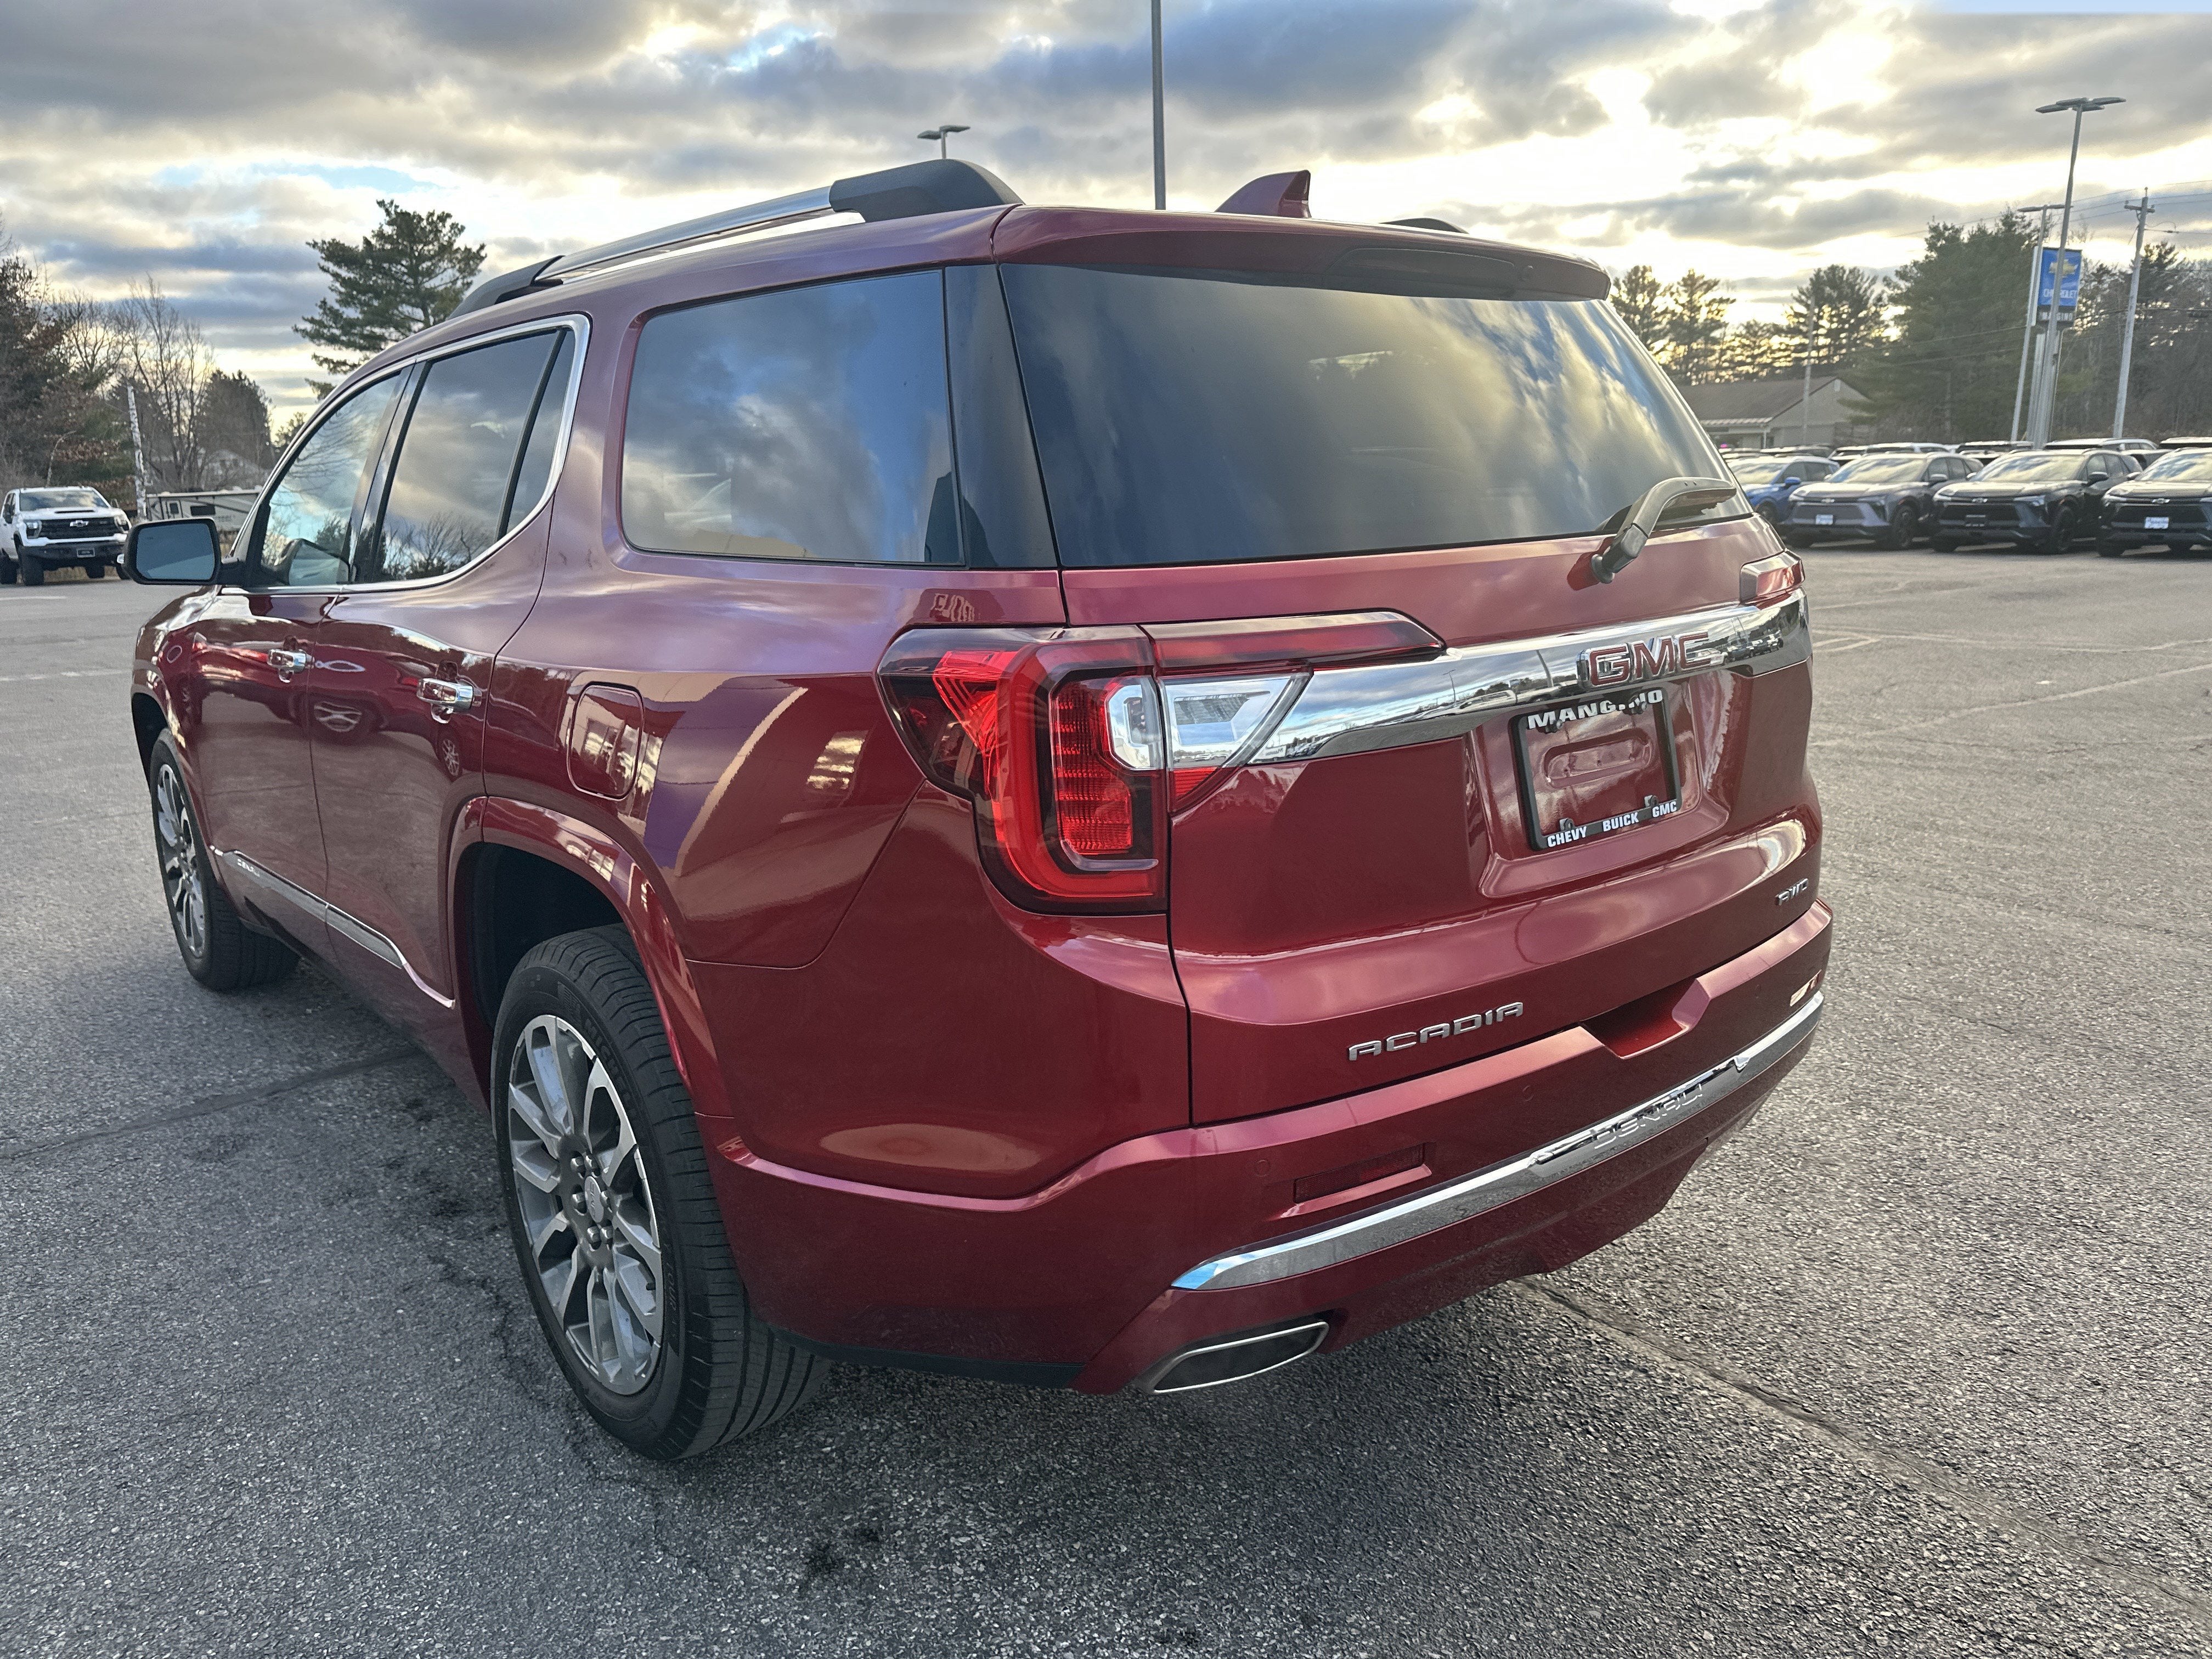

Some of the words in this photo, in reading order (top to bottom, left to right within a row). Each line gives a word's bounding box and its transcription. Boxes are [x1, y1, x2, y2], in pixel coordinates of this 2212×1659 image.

[1588, 629, 1712, 687] GMC
[1547, 826, 1587, 848] CHEVY
[1602, 812, 1639, 832] BUICK
[1652, 801, 1677, 817] GMC
[1348, 1002, 1523, 1061] ACADIA
